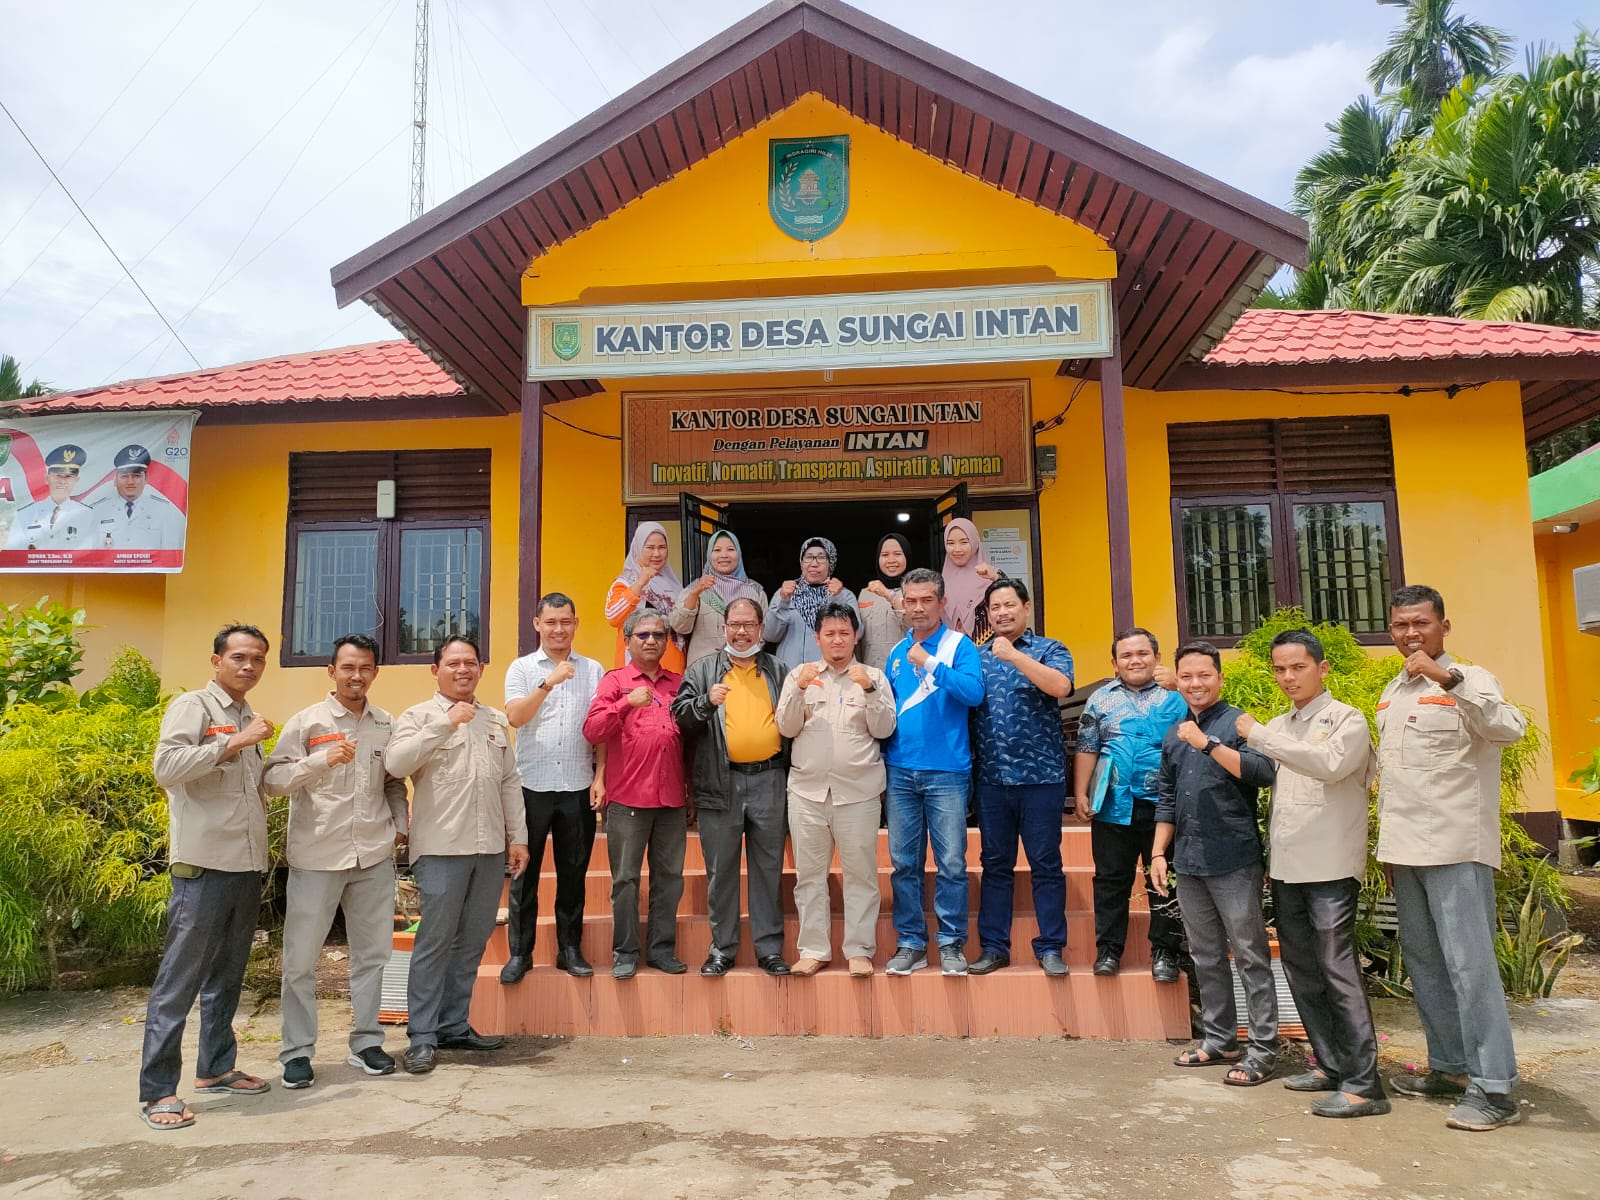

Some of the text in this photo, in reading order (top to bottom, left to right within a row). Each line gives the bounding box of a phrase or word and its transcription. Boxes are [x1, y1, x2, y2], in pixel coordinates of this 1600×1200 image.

[596, 305, 1079, 353] KANTOR DESA SUNGAI INTAN
[671, 402, 981, 429] KANTOR DESA SUNGAI INTAN
[165, 447, 188, 456] G20
[713, 431, 924, 452] Dengan Pelayanan INTAN
[652, 455, 1001, 483] Inovatif, Normatif, Transparan, Aspiratif & Nyaman
